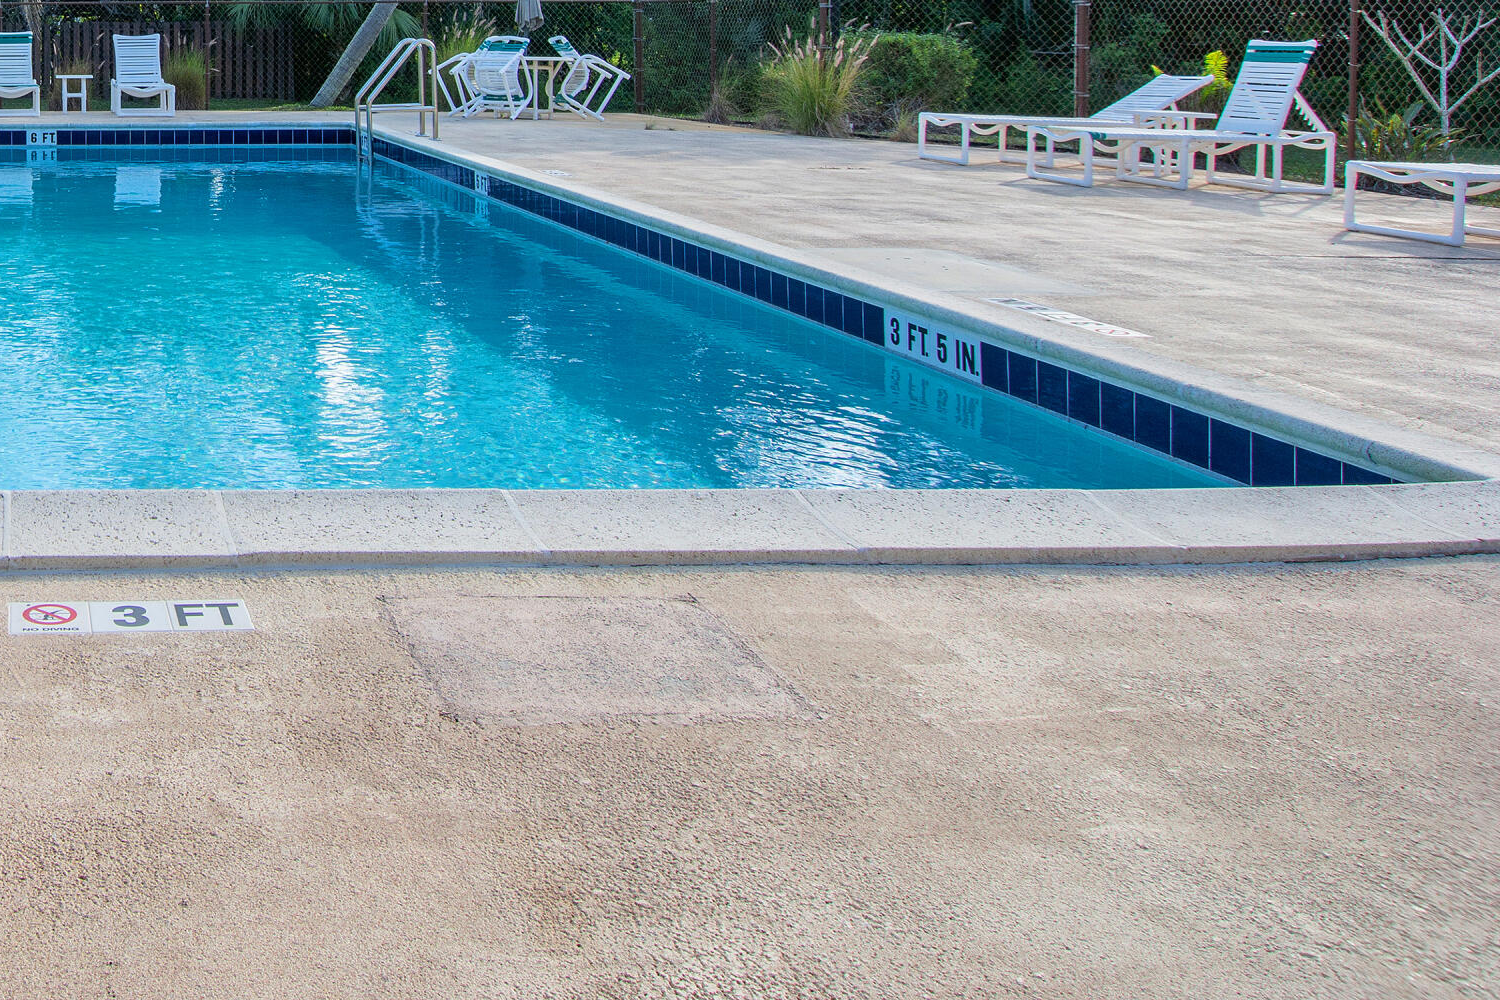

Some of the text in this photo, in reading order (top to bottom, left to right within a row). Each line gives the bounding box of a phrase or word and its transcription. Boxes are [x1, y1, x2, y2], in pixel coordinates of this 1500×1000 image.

[30, 132, 38, 143] 6
[890, 317, 980, 376] 3 FT. 5 IN.
[111, 603, 239, 627] 3 FT
